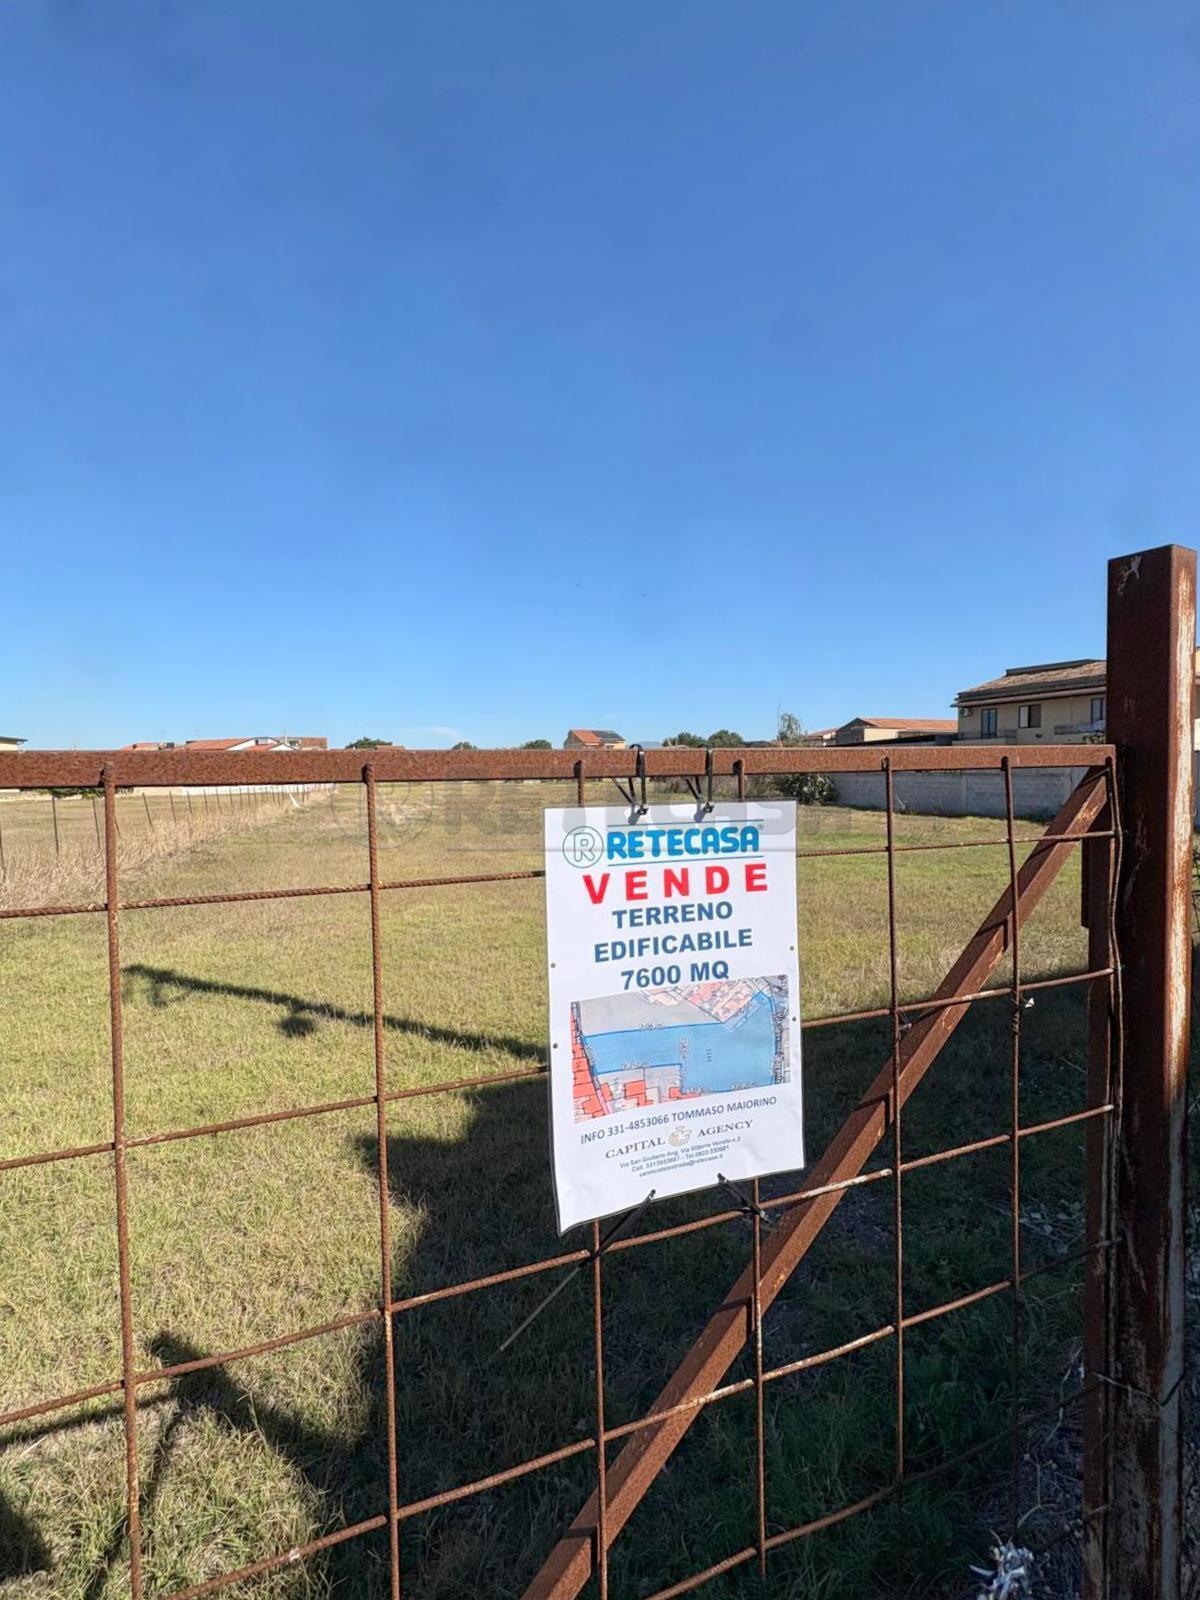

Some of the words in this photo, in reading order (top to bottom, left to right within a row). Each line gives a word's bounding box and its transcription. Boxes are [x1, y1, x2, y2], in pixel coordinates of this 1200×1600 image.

[607, 826, 760, 860] RETECASA
[582, 863, 768, 905] VENDE
[612, 901, 733, 929] TERRENO
[594, 928, 753, 963] EDIFICABILE
[621, 964, 681, 990] 7600
[690, 960, 730, 982] MQ
[580, 1129, 605, 1144] INFO
[607, 1114, 670, 1138] 331-4853066
[671, 1104, 724, 1122] TOMMASO
[727, 1096, 777, 1112] MAIORINO
[605, 1137, 666, 1159] CAPITAL
[697, 1119, 753, 1137] AGENCY
